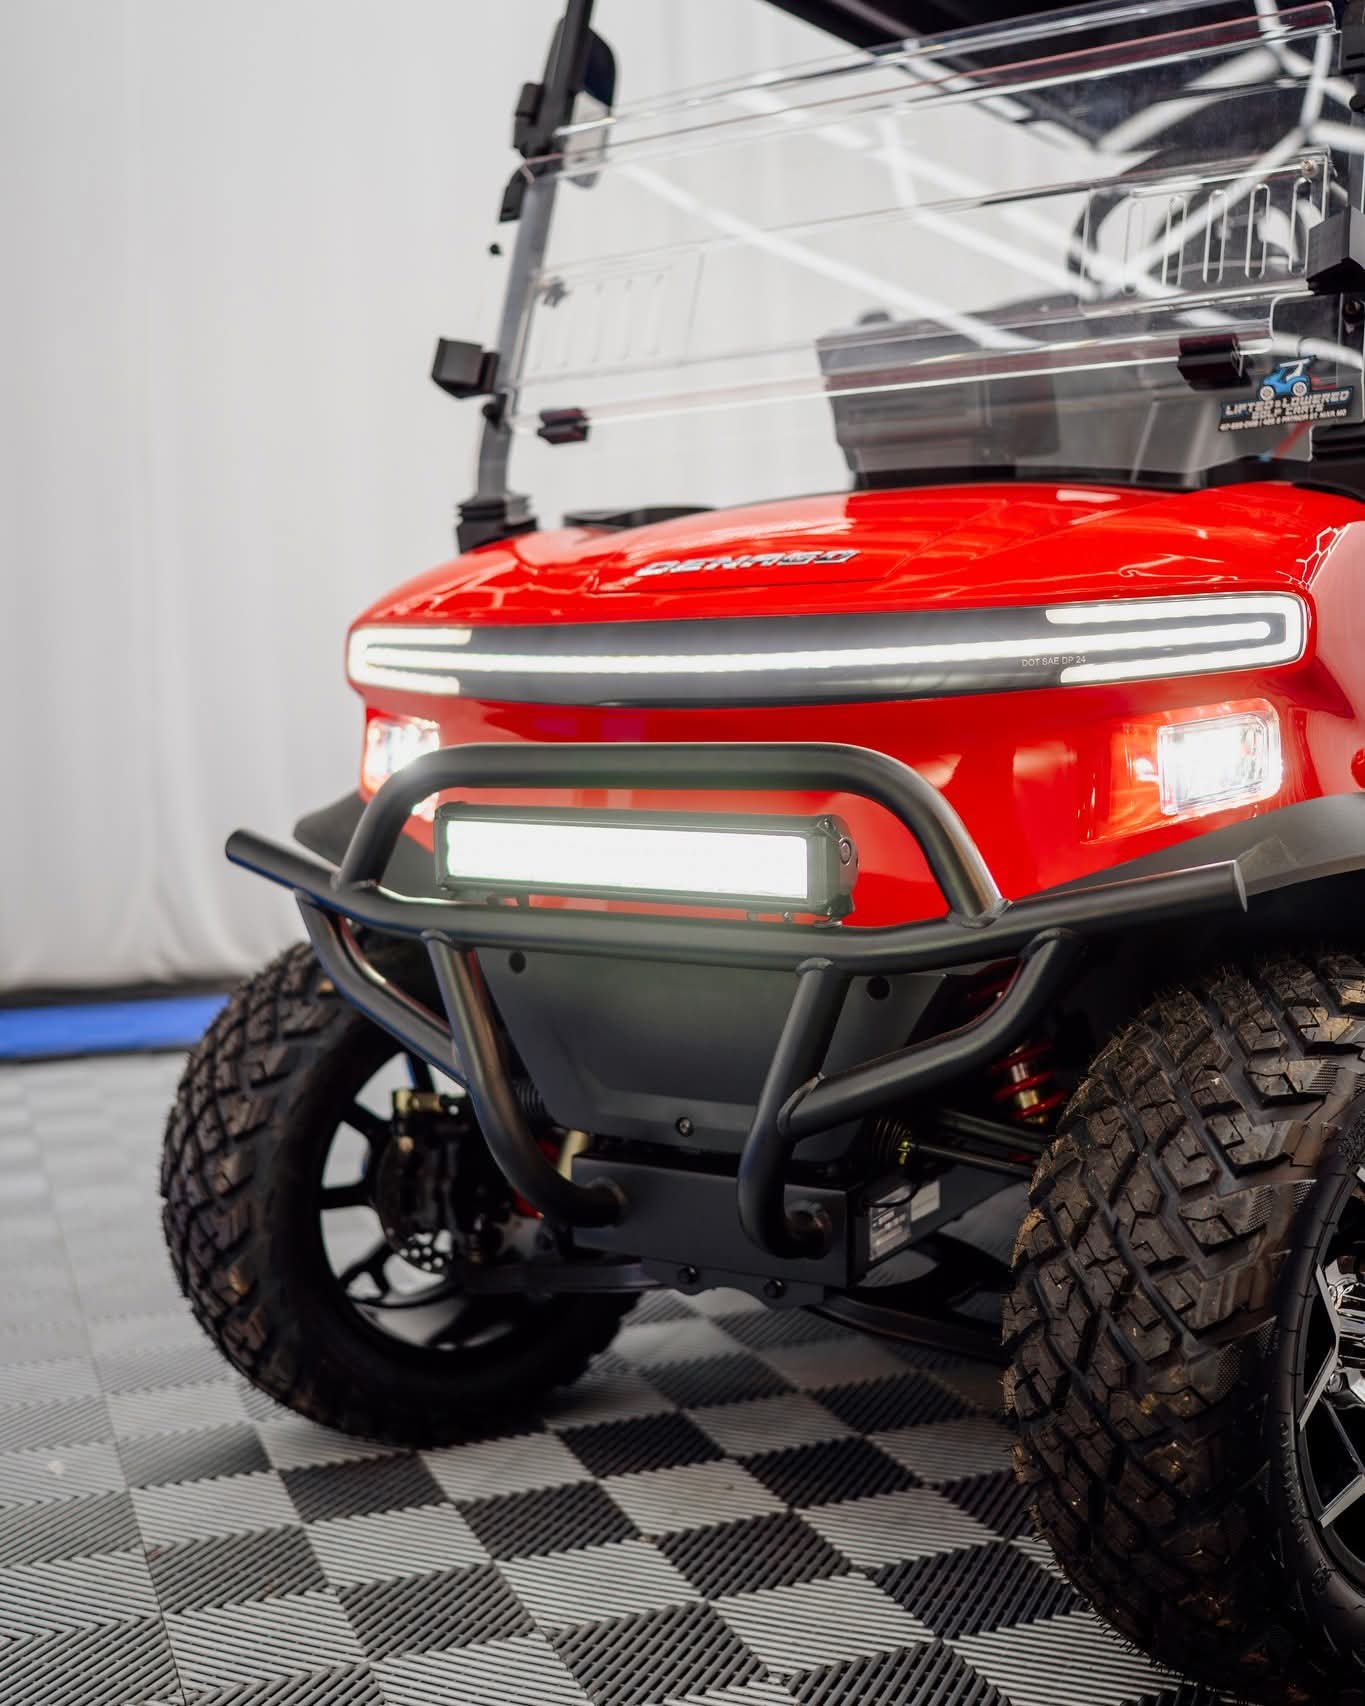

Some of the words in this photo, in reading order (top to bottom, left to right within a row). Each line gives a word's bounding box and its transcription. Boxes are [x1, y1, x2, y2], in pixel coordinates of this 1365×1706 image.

[1225, 400, 1274, 416] LIFTED
[1282, 390, 1350, 409] LOWERED
[1251, 408, 1283, 420] GOLF
[1285, 403, 1325, 416] CARTS
[634, 548, 861, 577] DENAGO
[1022, 658, 1041, 667] DOT
[1042, 657, 1060, 666] SAE
[1061, 656, 1074, 665] DP
[1076, 655, 1087, 664] 24
